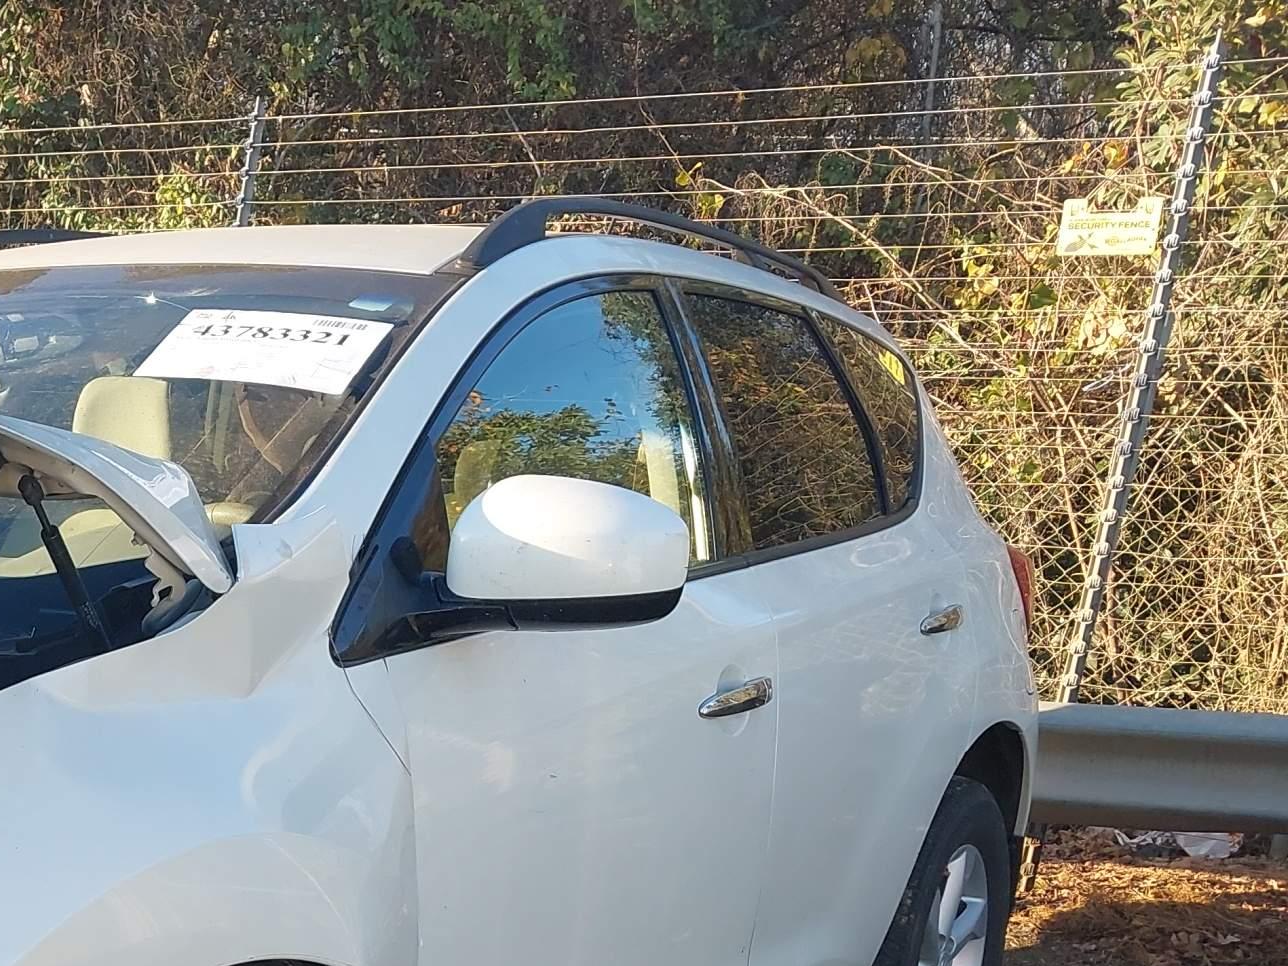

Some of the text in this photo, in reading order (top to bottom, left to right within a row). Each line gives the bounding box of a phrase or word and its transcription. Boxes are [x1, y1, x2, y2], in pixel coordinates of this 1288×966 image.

[1067, 220, 1151, 230] SECURITY FENCE
[192, 324, 351, 346] 43783321
